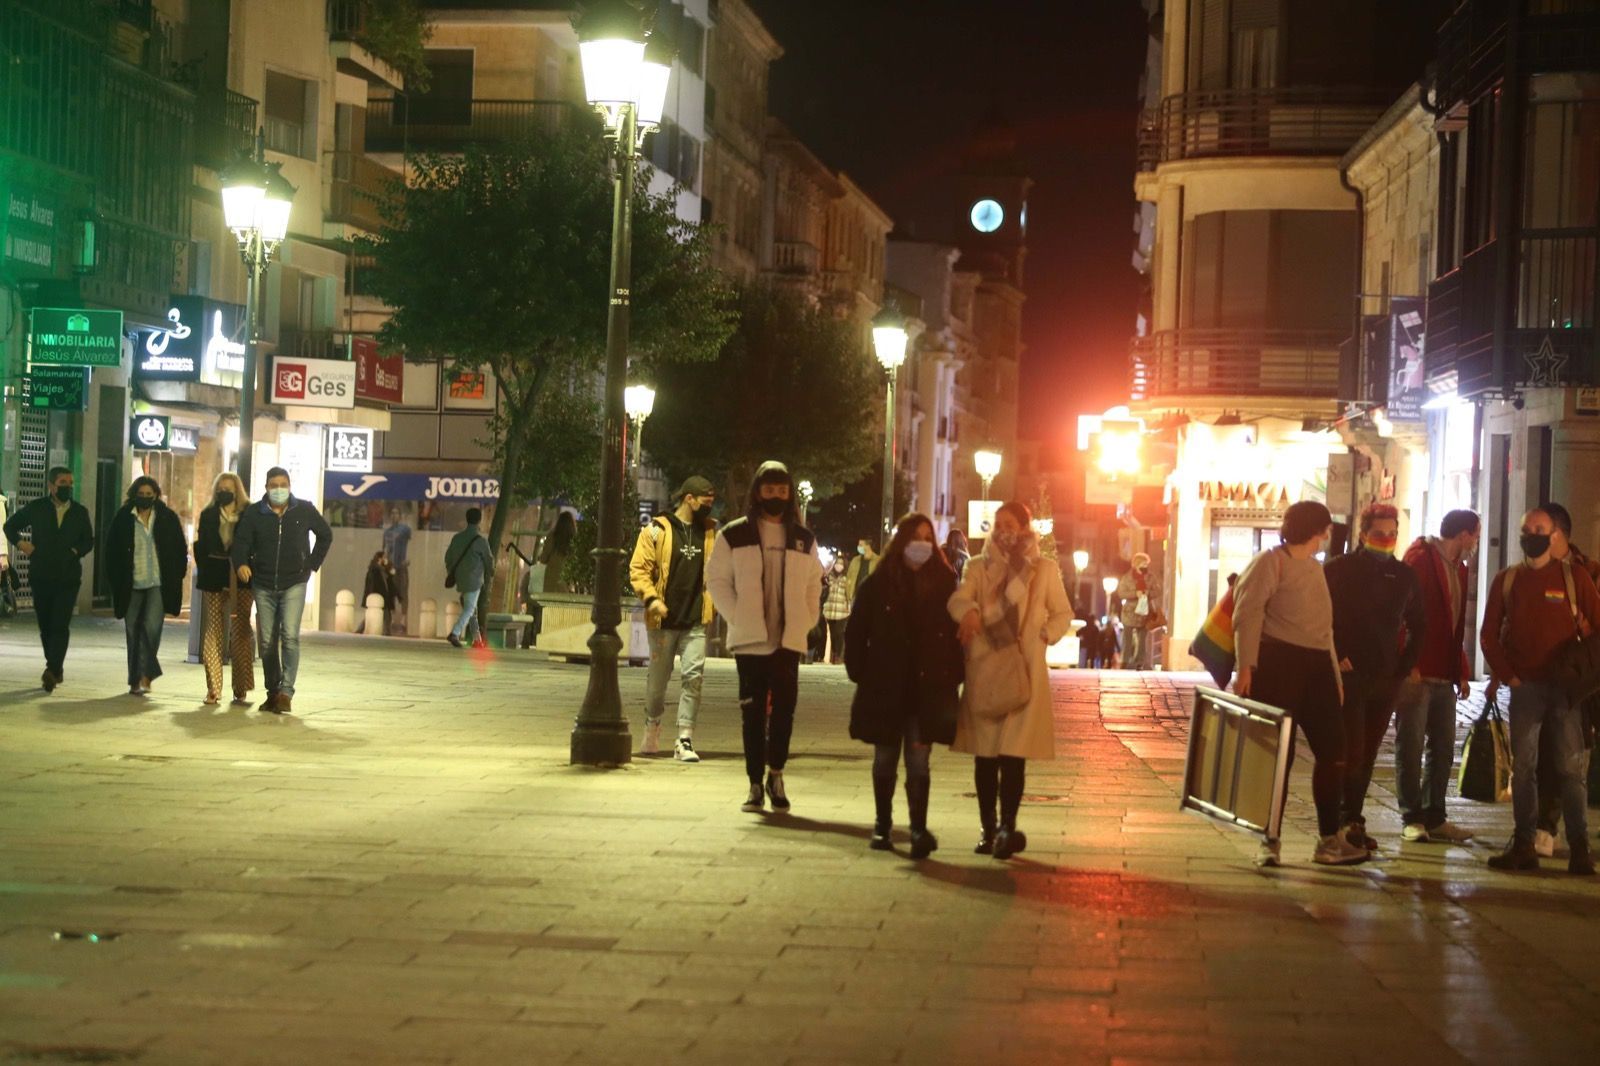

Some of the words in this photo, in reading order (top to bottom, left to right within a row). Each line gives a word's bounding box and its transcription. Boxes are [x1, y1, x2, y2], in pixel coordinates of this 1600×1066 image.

[36, 333, 116, 348] INMOBILIARIA
[34, 349, 70, 361] Jesús
[33, 369, 83, 378] Salamandra
[33, 384, 64, 395] Viajes
[307, 375, 346, 397] Ges
